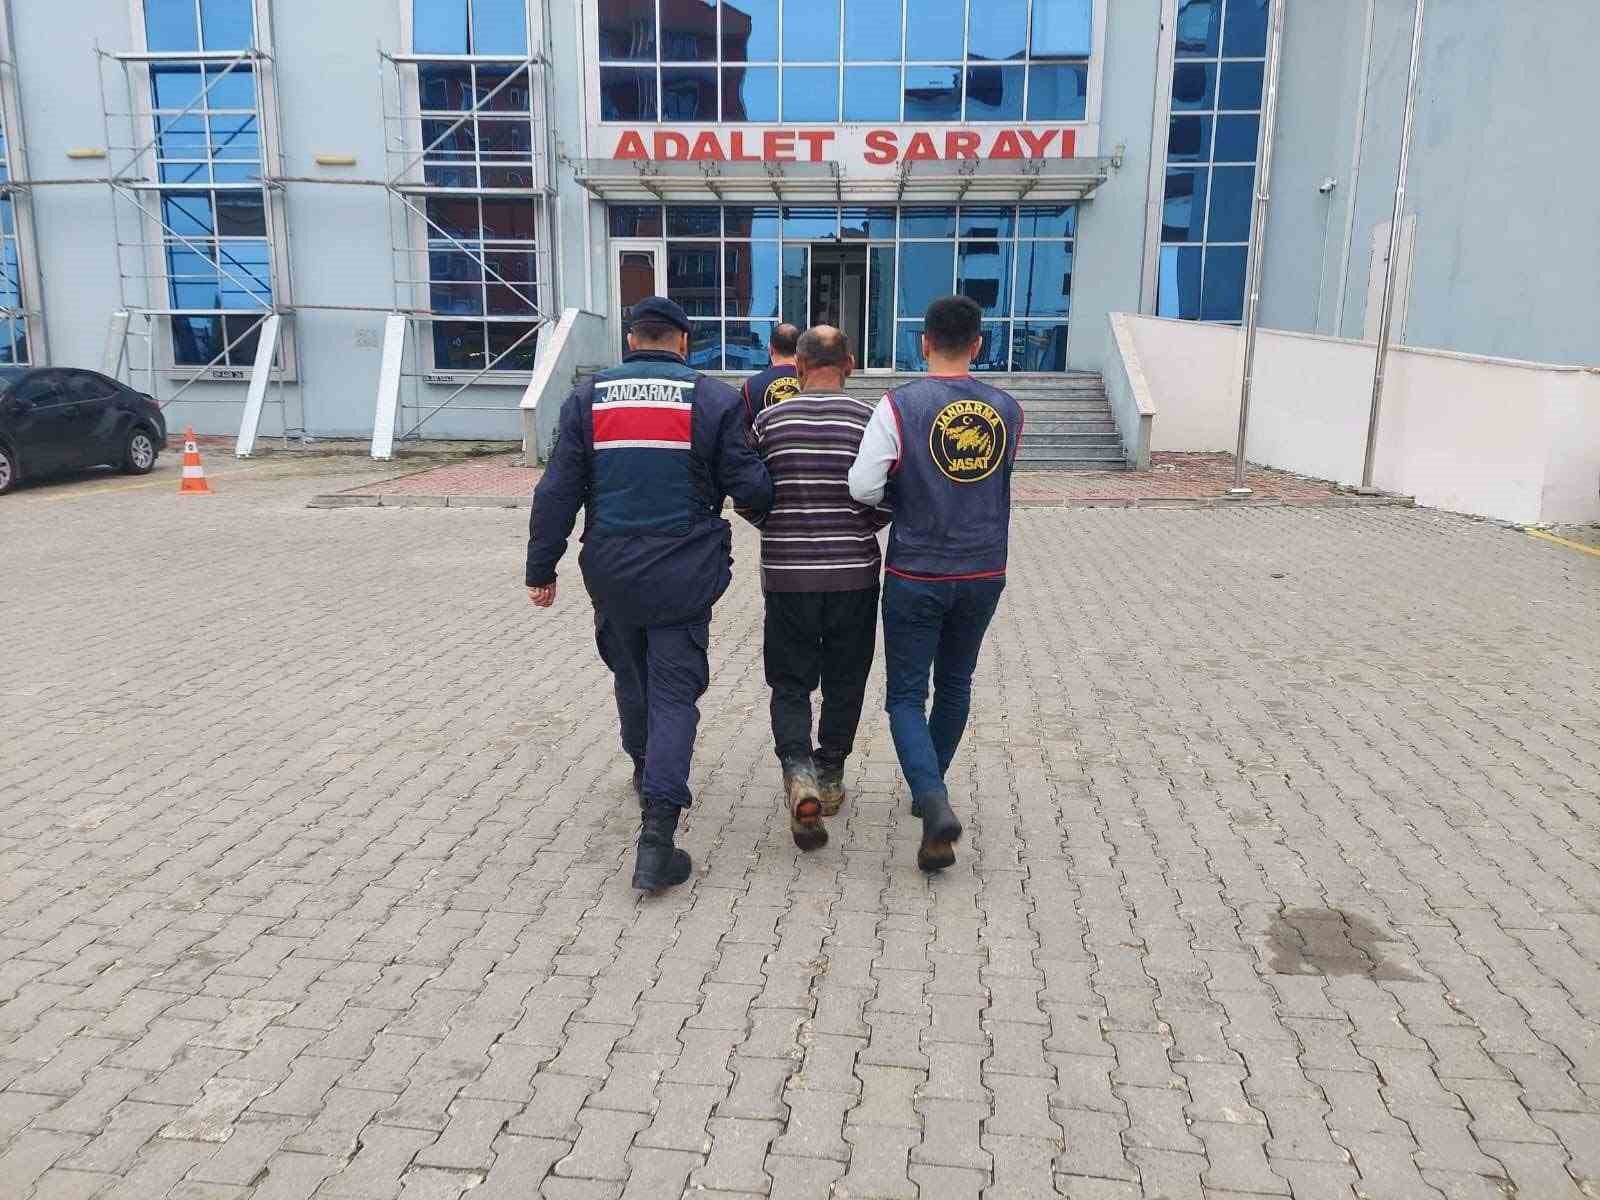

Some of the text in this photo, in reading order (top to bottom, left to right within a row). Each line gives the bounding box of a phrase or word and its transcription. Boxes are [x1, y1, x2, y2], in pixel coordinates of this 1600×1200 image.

[613, 129, 1075, 164] ADALET SARAYI
[601, 383, 684, 403] JANDARMA
[936, 401, 1000, 431] JANDARMA
[948, 456, 990, 472] JASAT
